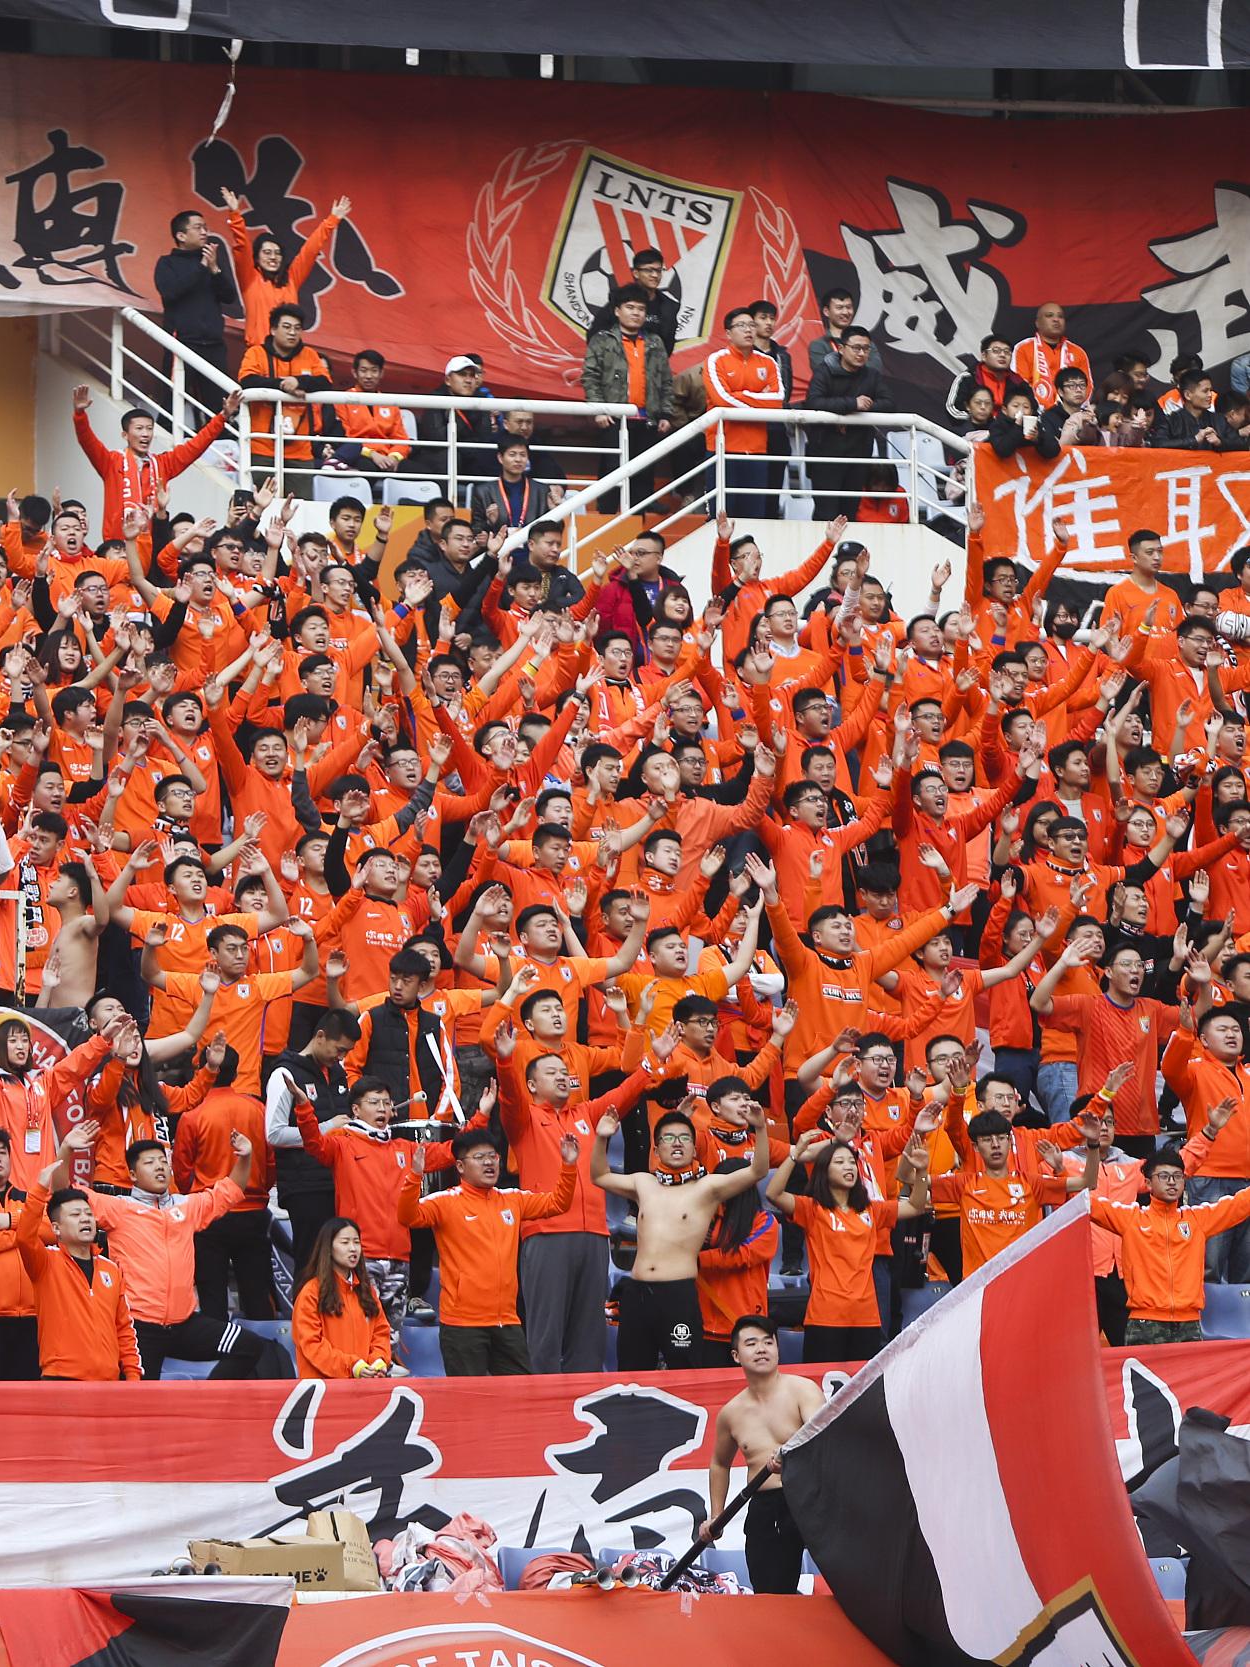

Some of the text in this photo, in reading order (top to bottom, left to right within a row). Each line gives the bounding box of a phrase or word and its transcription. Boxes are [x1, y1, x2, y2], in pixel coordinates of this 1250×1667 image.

[593, 170, 714, 227] LNTS
[563, 271, 592, 327] SHANDON
[299, 897, 314, 916] 12
[171, 923, 186, 943] 12
[829, 1211, 846, 1232] 12
